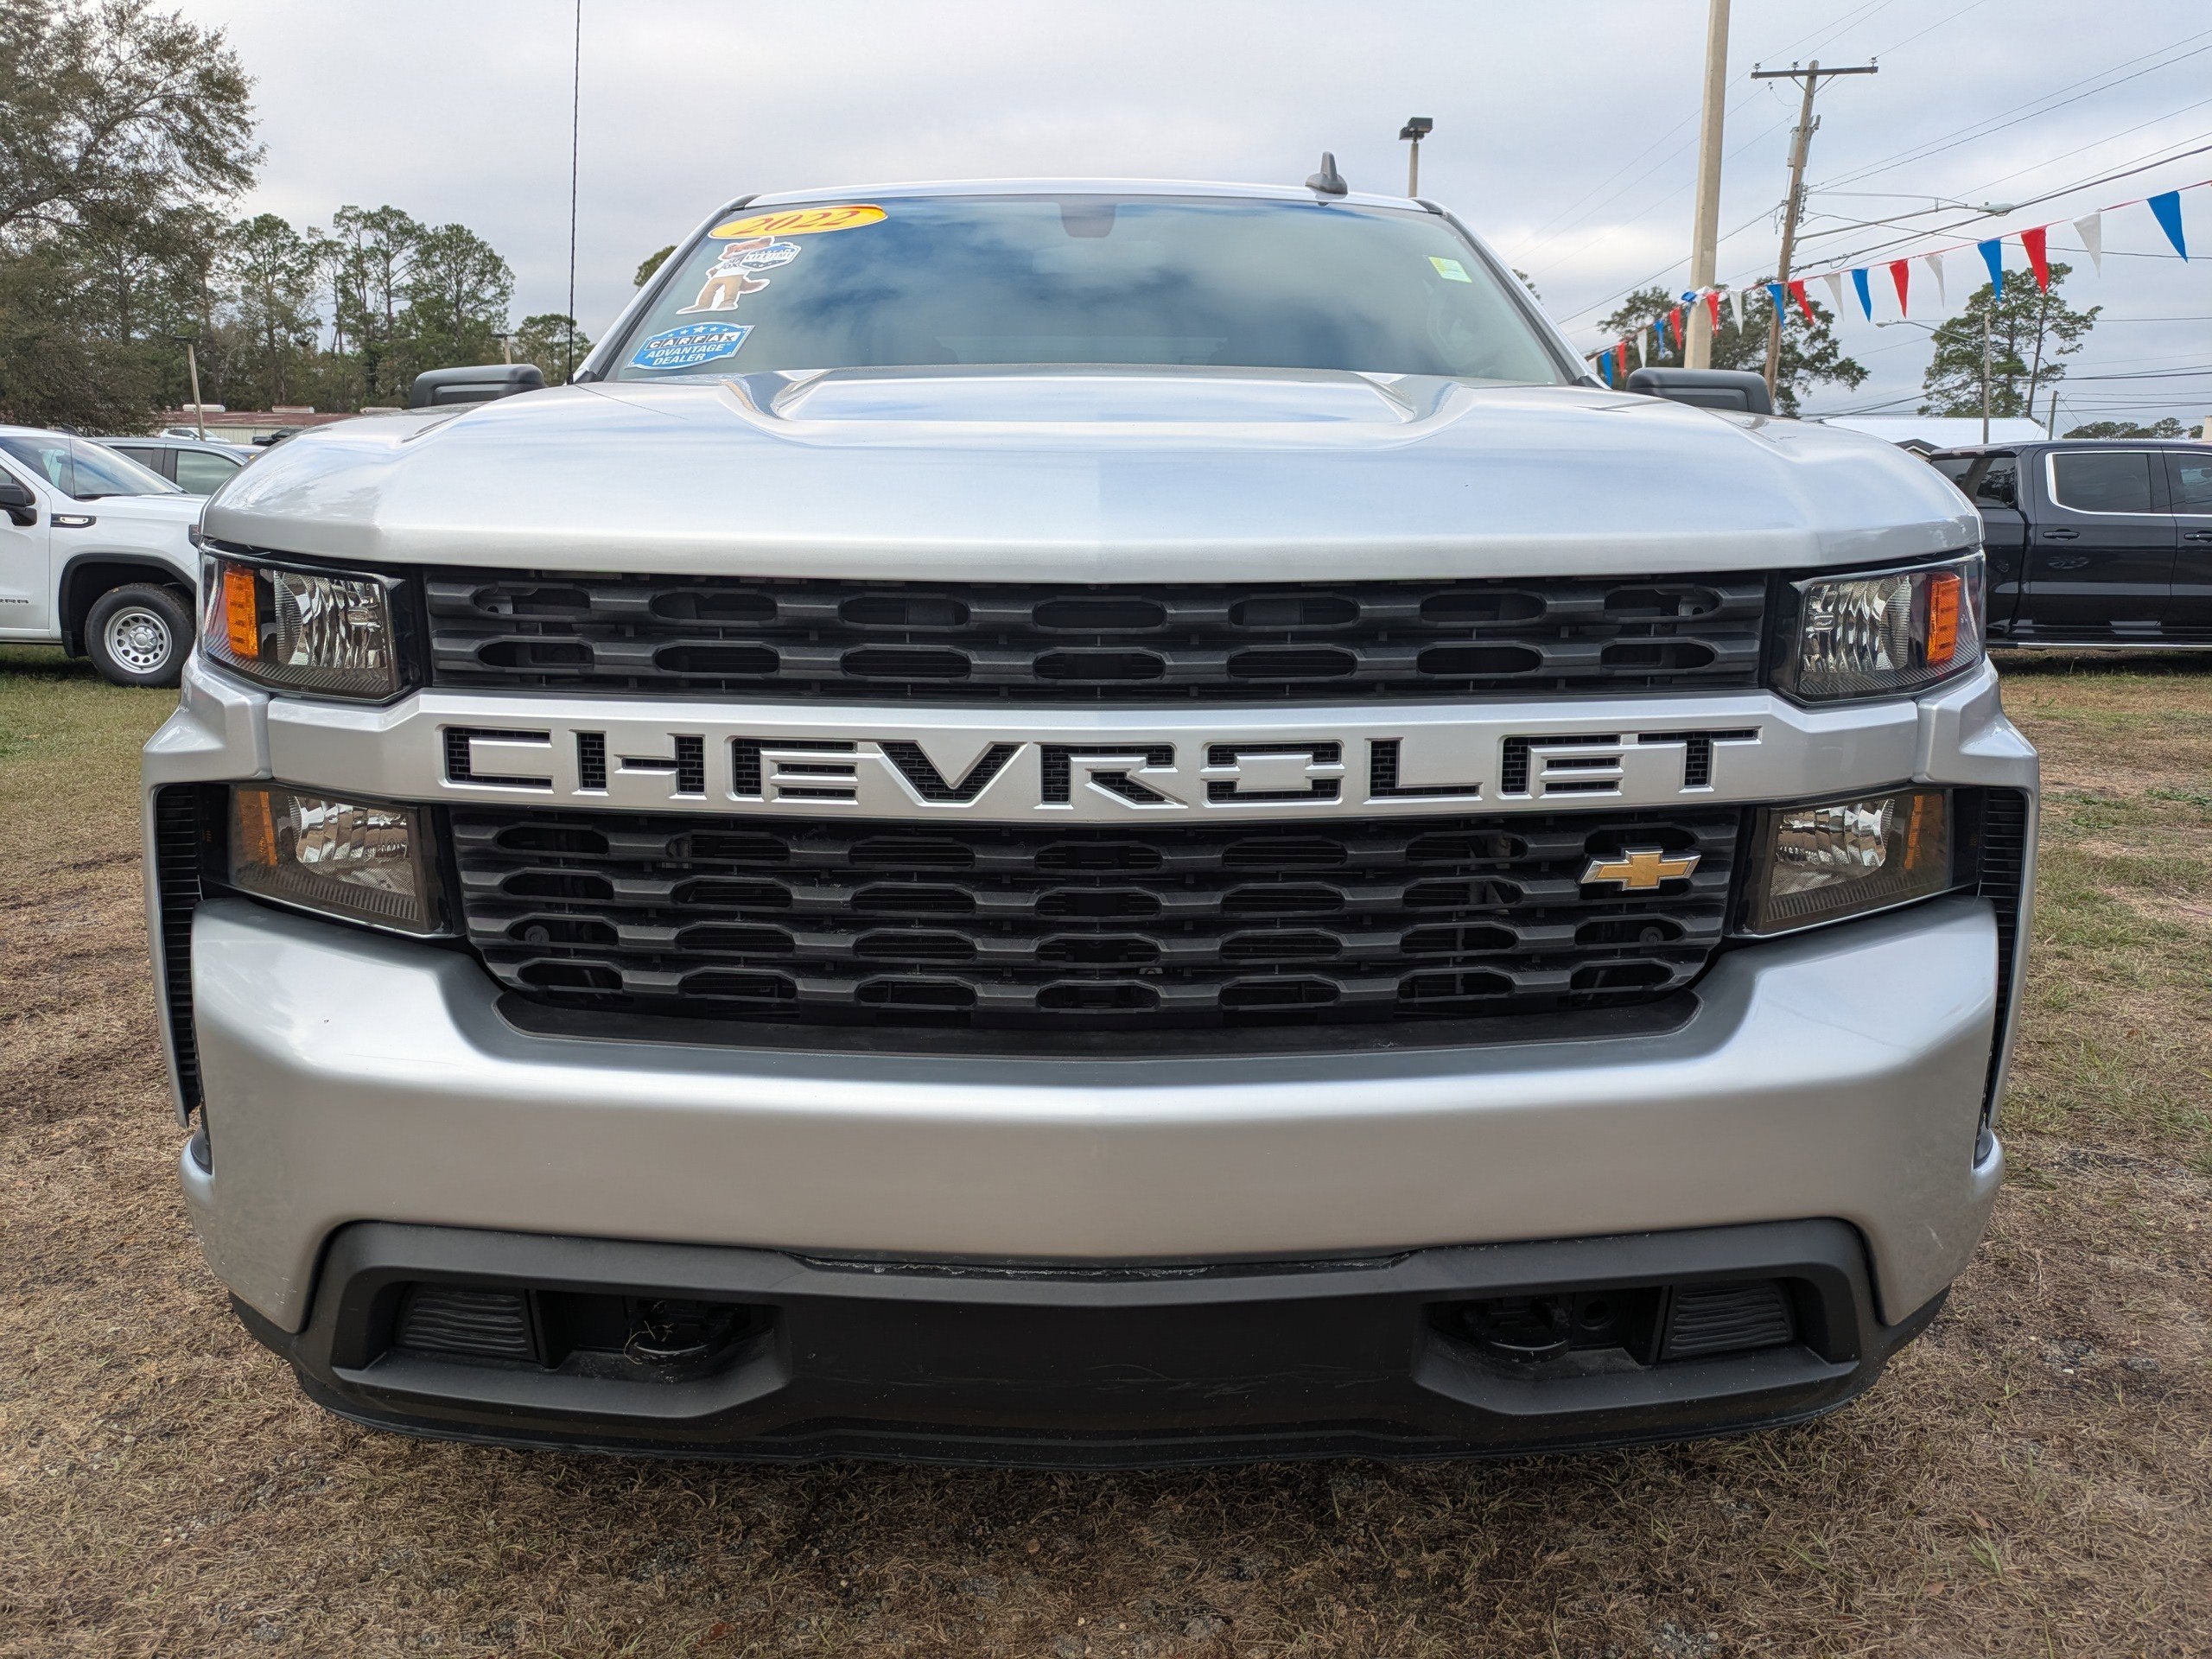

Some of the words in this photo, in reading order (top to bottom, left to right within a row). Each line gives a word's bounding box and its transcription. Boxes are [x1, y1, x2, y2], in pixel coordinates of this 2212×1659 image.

[730, 210, 861, 235] 2022
[647, 332, 741, 349] CARFAX
[645, 343, 724, 359] ADVANTAGE
[652, 353, 706, 365] DEALER
[442, 727, 1759, 807] CHEVROLET
